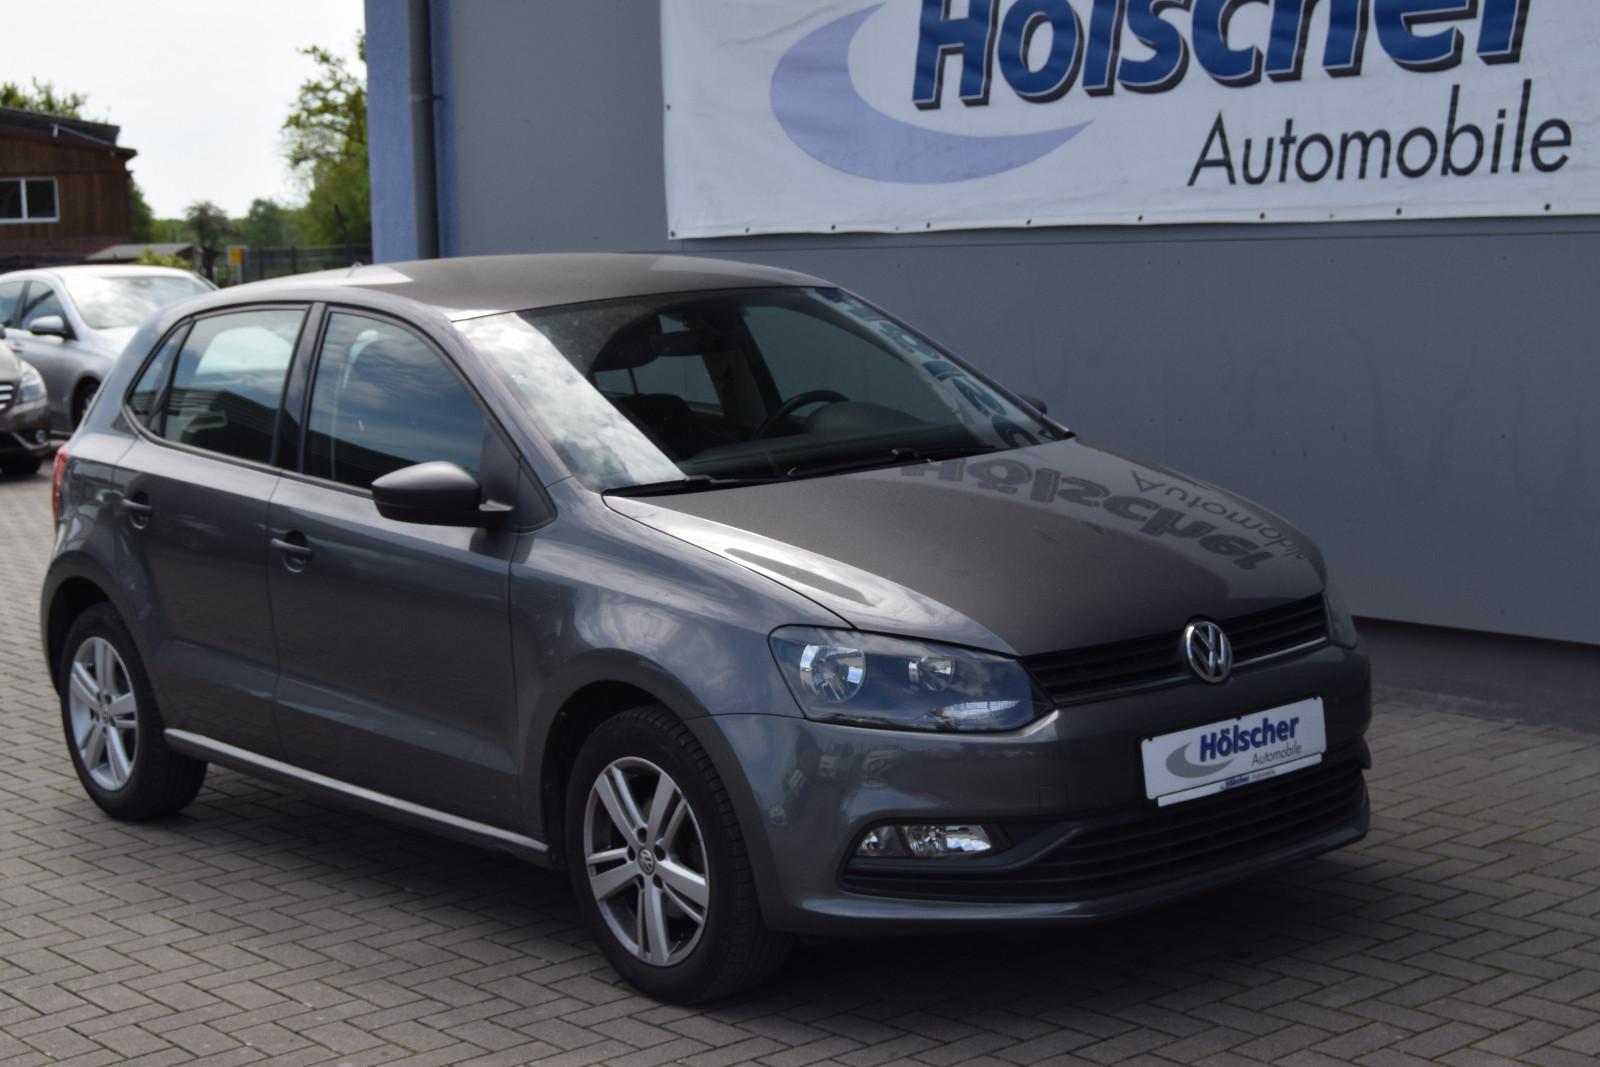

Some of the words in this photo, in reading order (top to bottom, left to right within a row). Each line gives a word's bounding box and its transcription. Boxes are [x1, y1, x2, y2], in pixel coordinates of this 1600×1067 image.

[1187, 79, 1572, 187] Automobile
[1200, 717, 1299, 762] Hölscher
[1251, 740, 1302, 767] Automobile
